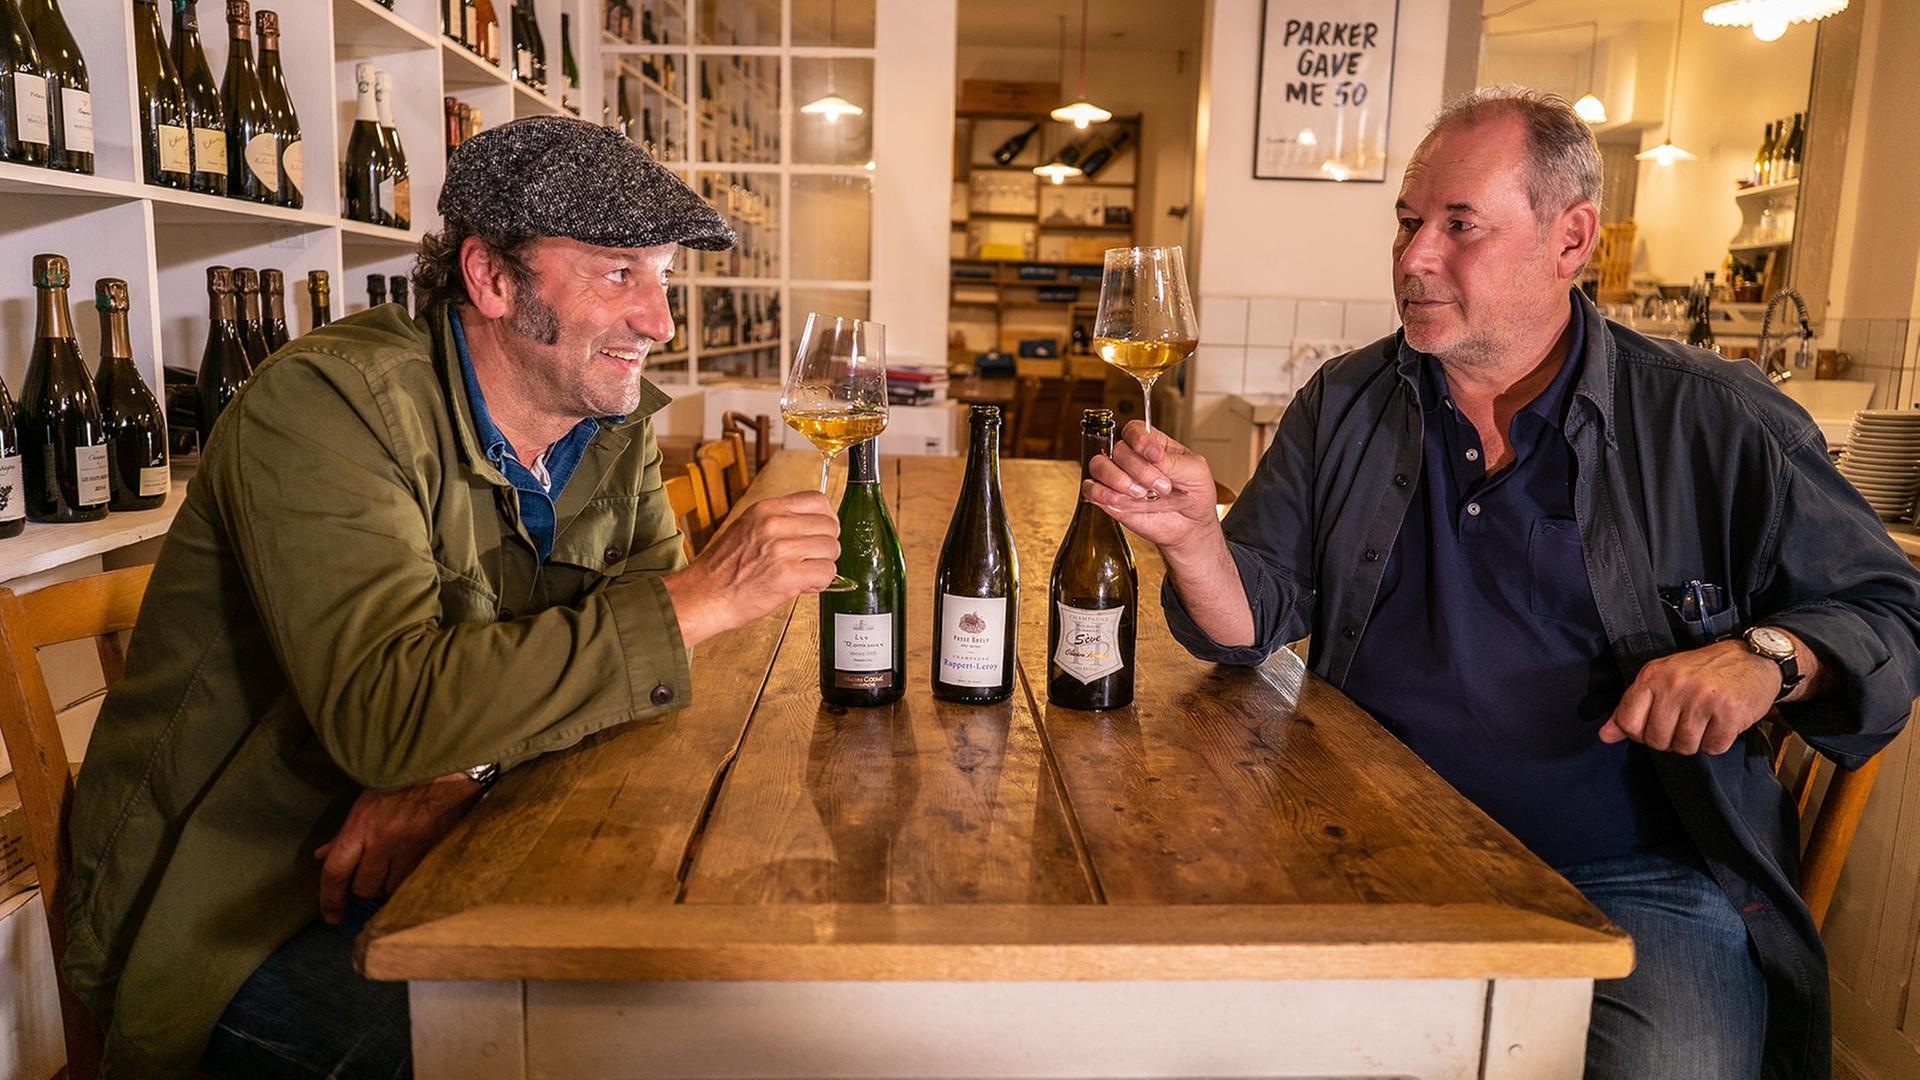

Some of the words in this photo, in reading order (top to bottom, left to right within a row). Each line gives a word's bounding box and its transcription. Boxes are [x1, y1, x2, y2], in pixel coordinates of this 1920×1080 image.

[1283, 19, 1378, 49] PARKER
[1297, 49, 1363, 77] GAVE
[1286, 81, 1327, 107] ME
[1334, 81, 1368, 107] 50
[943, 658, 998, 671] Ruppert-Leroy
